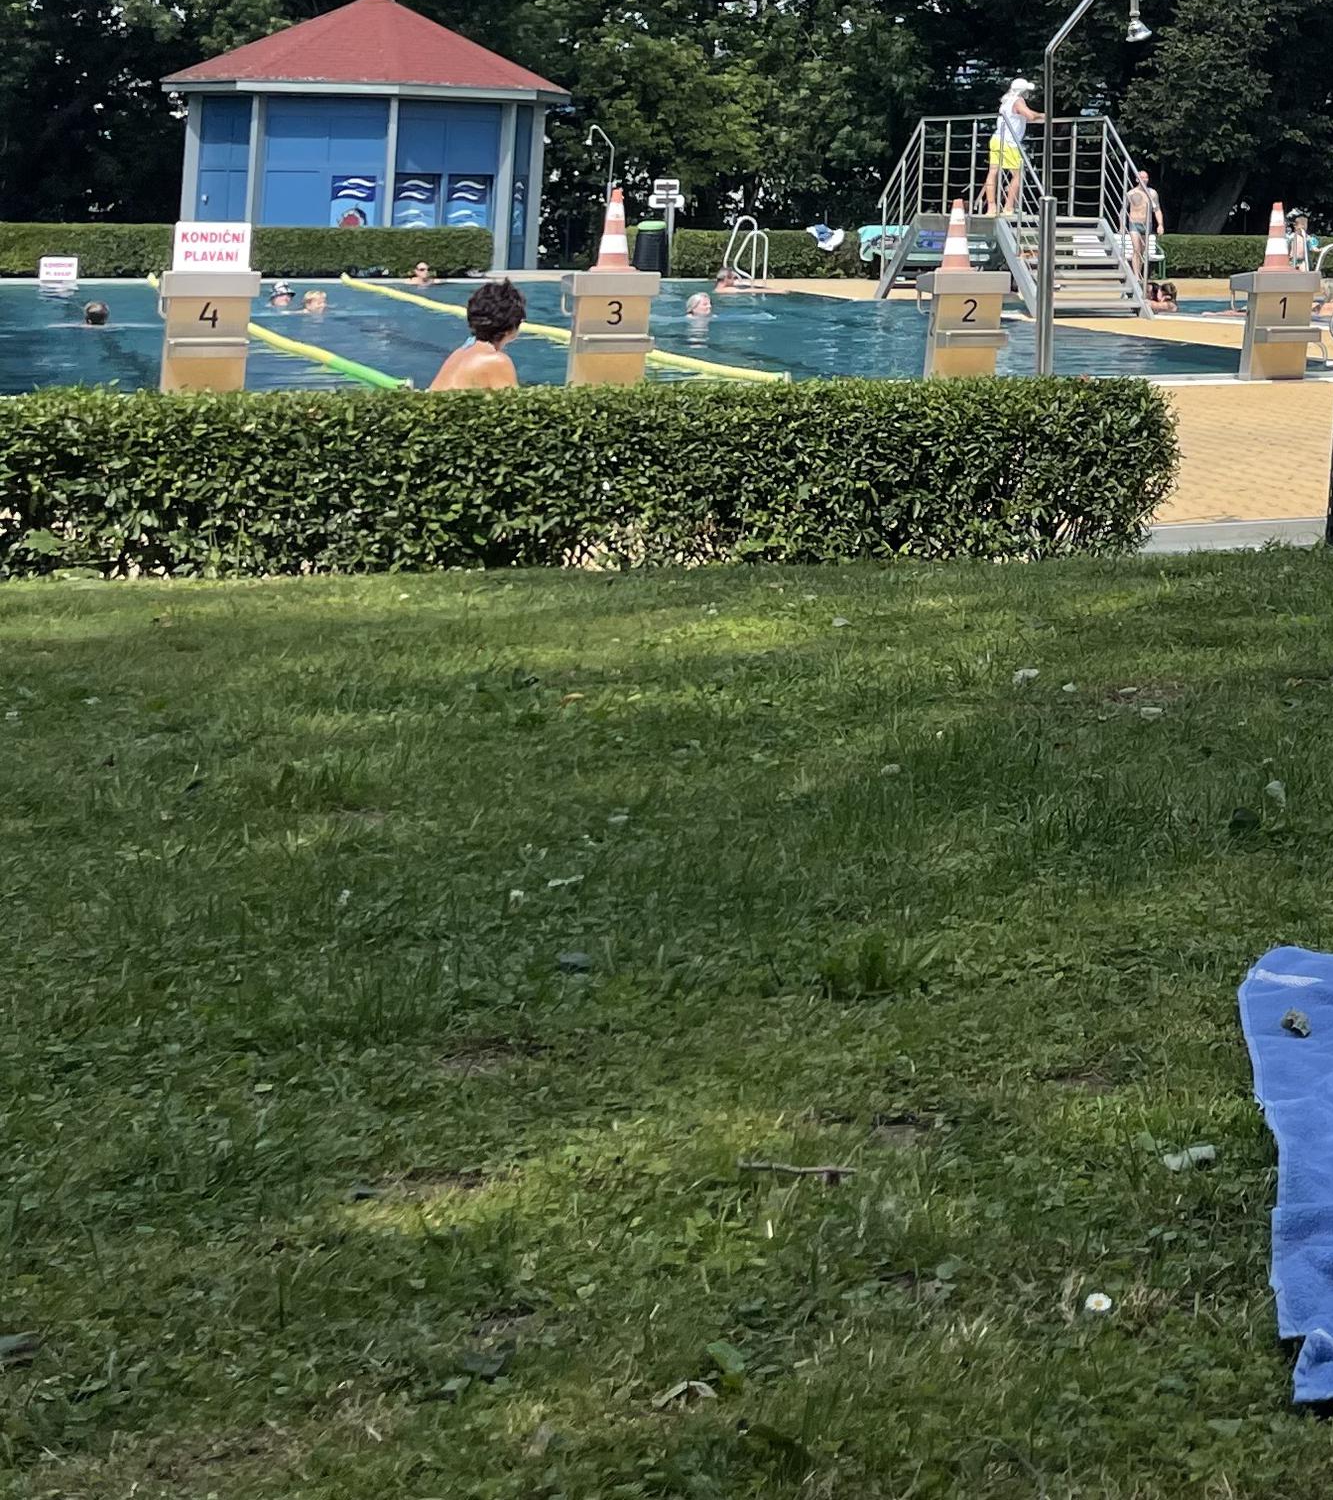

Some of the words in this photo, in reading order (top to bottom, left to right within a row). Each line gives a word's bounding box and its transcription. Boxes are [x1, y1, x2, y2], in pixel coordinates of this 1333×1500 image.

[181, 229, 245, 244] KONDIČNÍ
[199, 301, 218, 329] 4
[606, 300, 623, 326] 3
[961, 299, 978, 323] 2
[1279, 296, 1288, 320] 1
